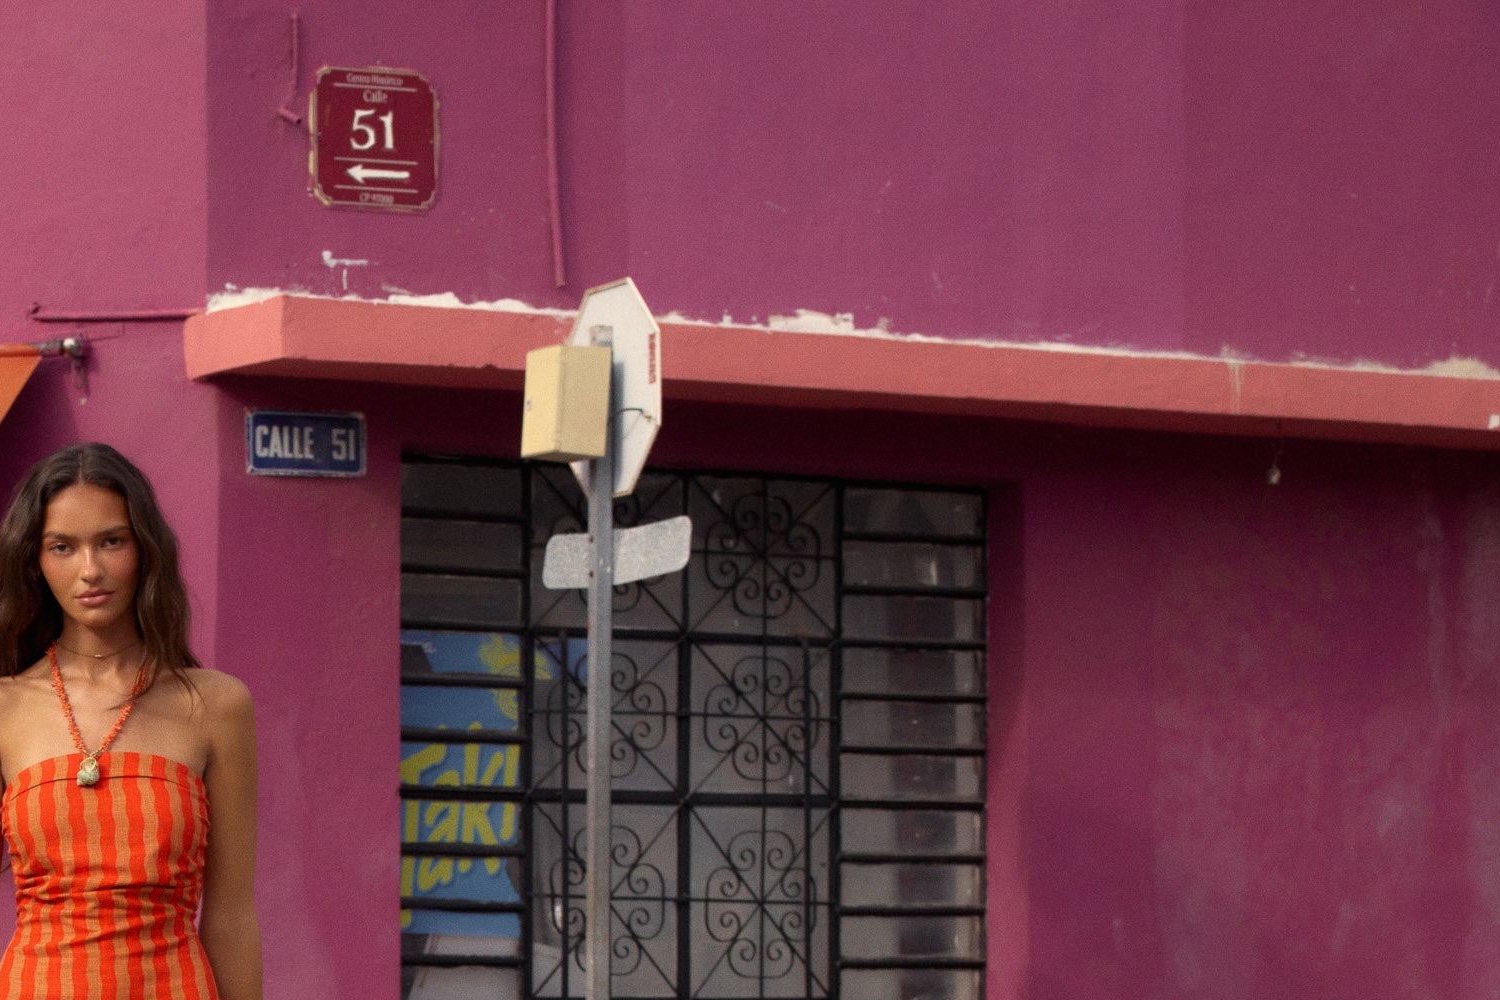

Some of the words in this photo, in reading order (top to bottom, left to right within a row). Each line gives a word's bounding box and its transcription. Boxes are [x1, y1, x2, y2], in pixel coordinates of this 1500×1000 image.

[363, 90, 388, 103] Calle
[350, 109, 394, 150] 51
[255, 424, 315, 459] CALLE
[331, 427, 357, 461] 51
